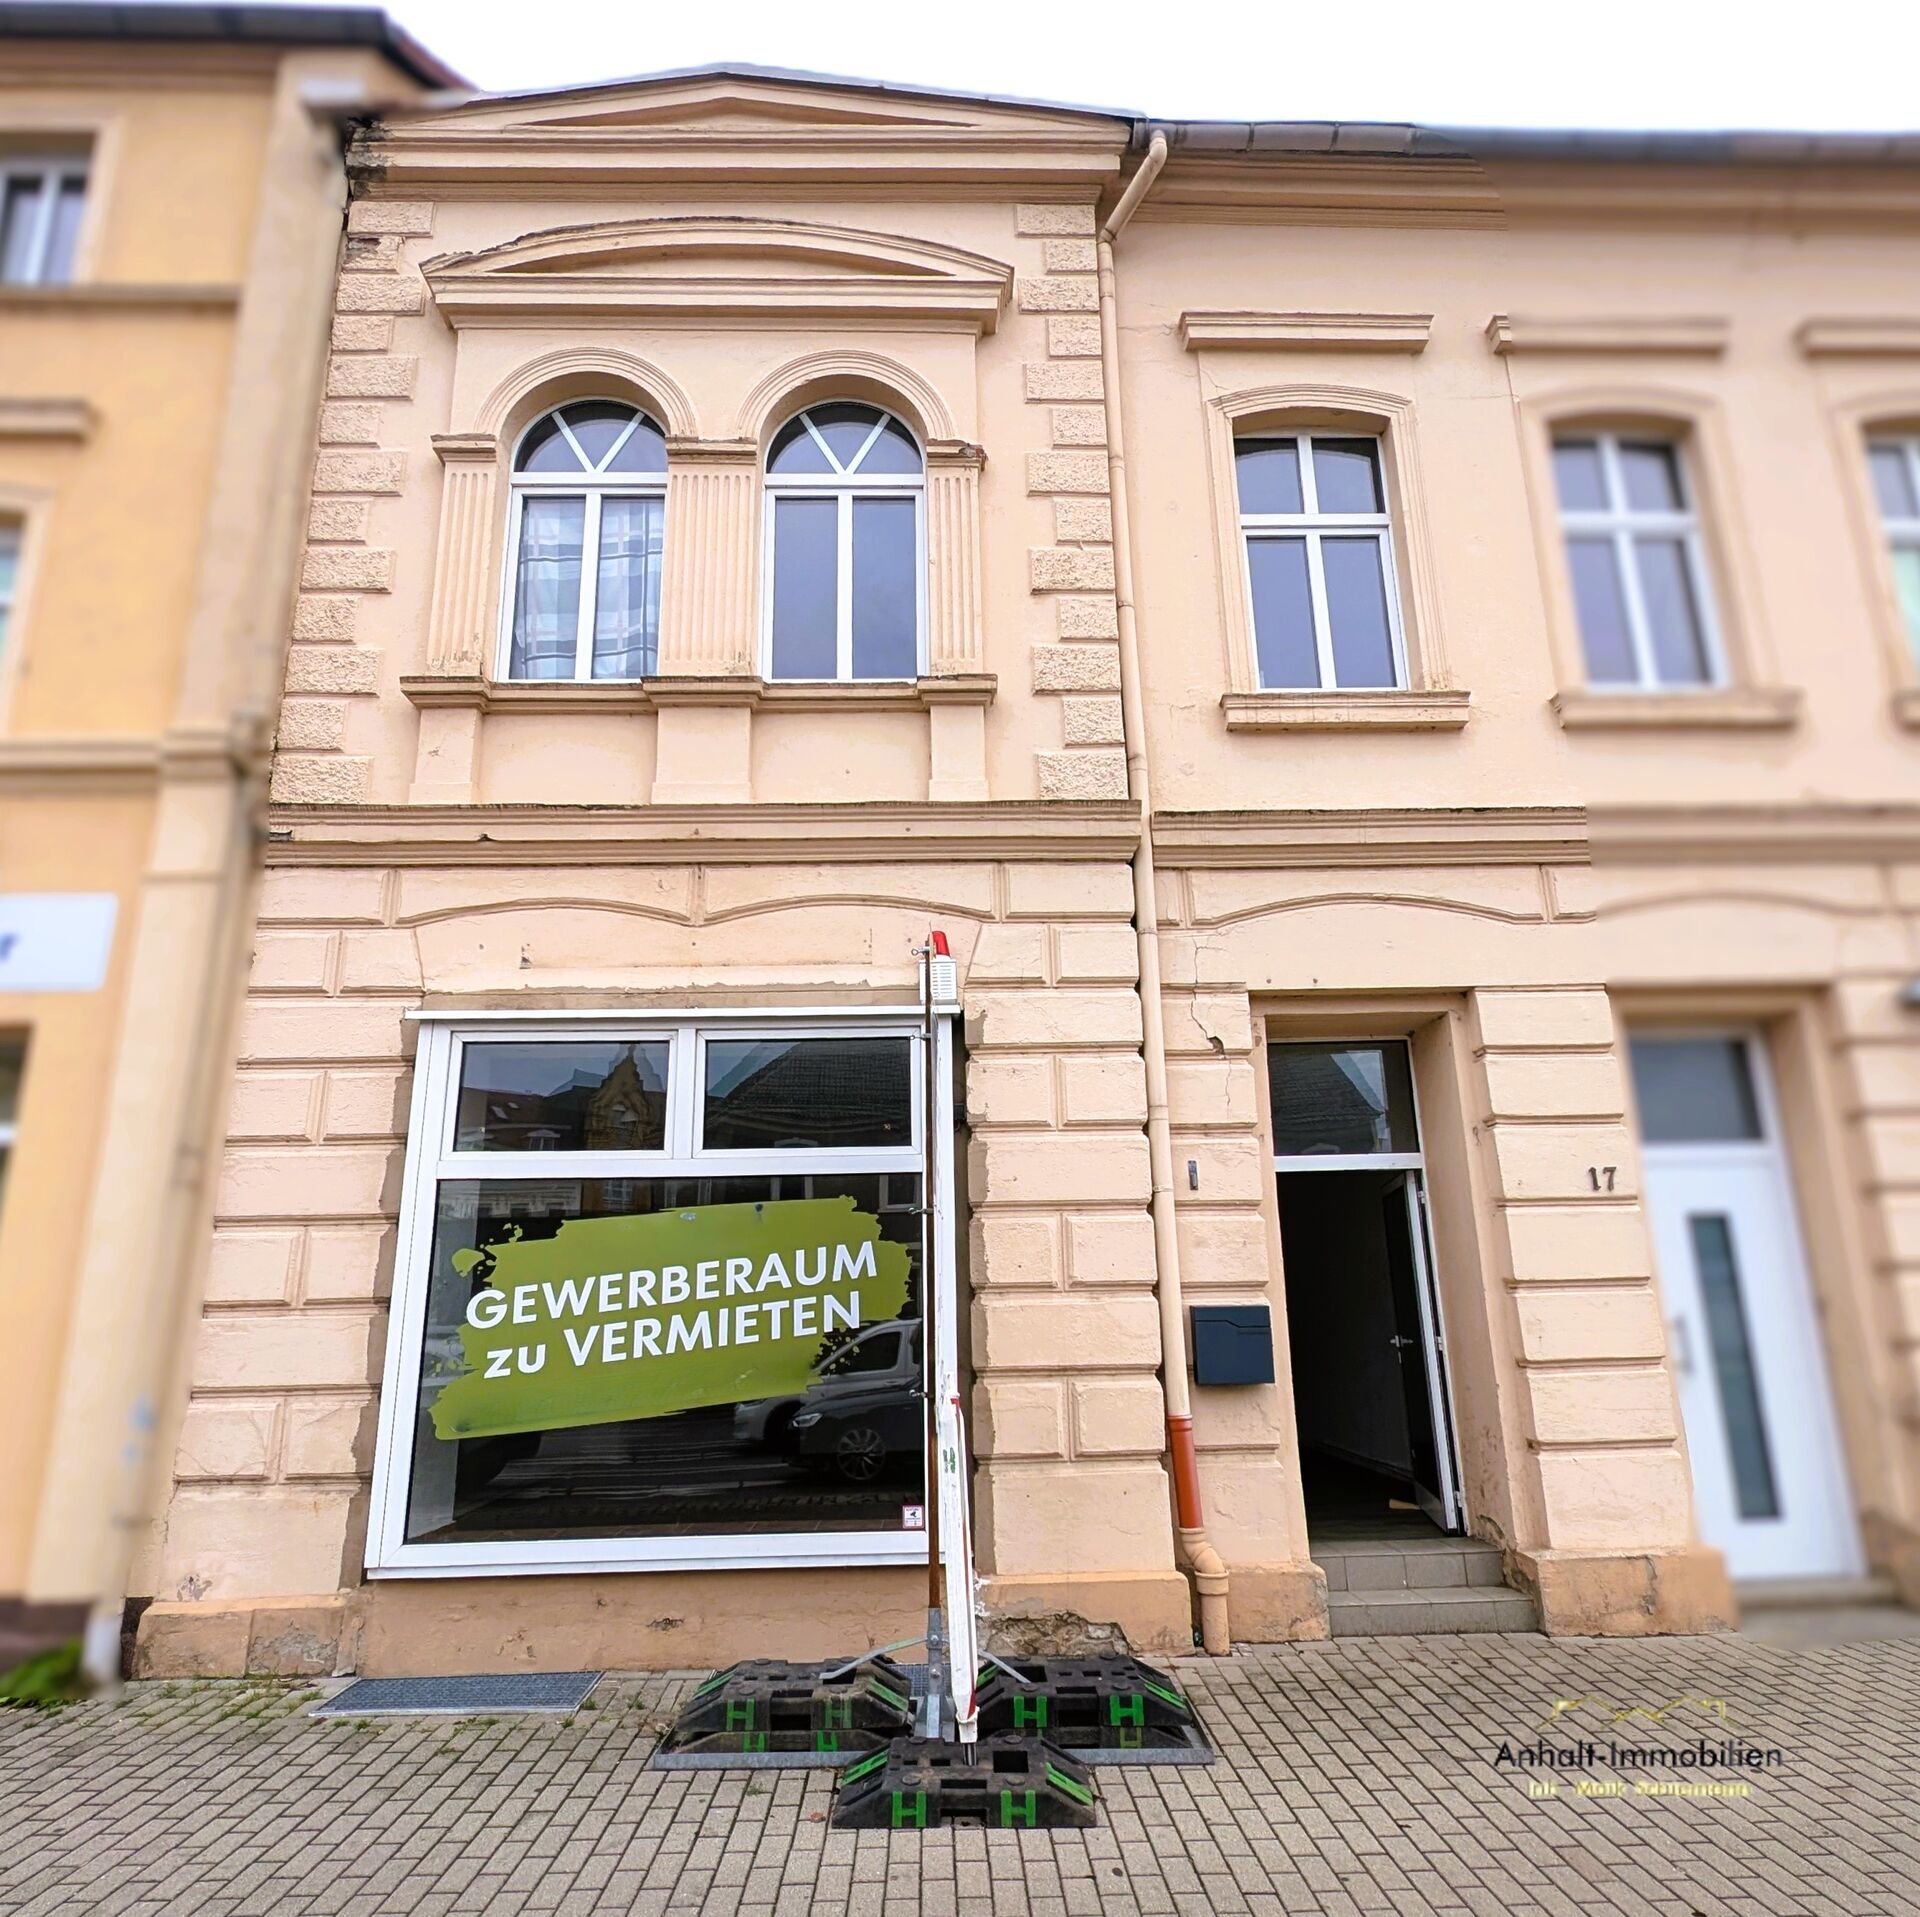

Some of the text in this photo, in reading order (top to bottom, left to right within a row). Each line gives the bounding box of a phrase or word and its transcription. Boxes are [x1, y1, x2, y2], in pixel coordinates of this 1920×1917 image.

[1588, 1166, 1617, 1191] 17
[466, 1240, 877, 1329] GEWERBERAUM
[563, 1290, 861, 1367] VERMIETEN
